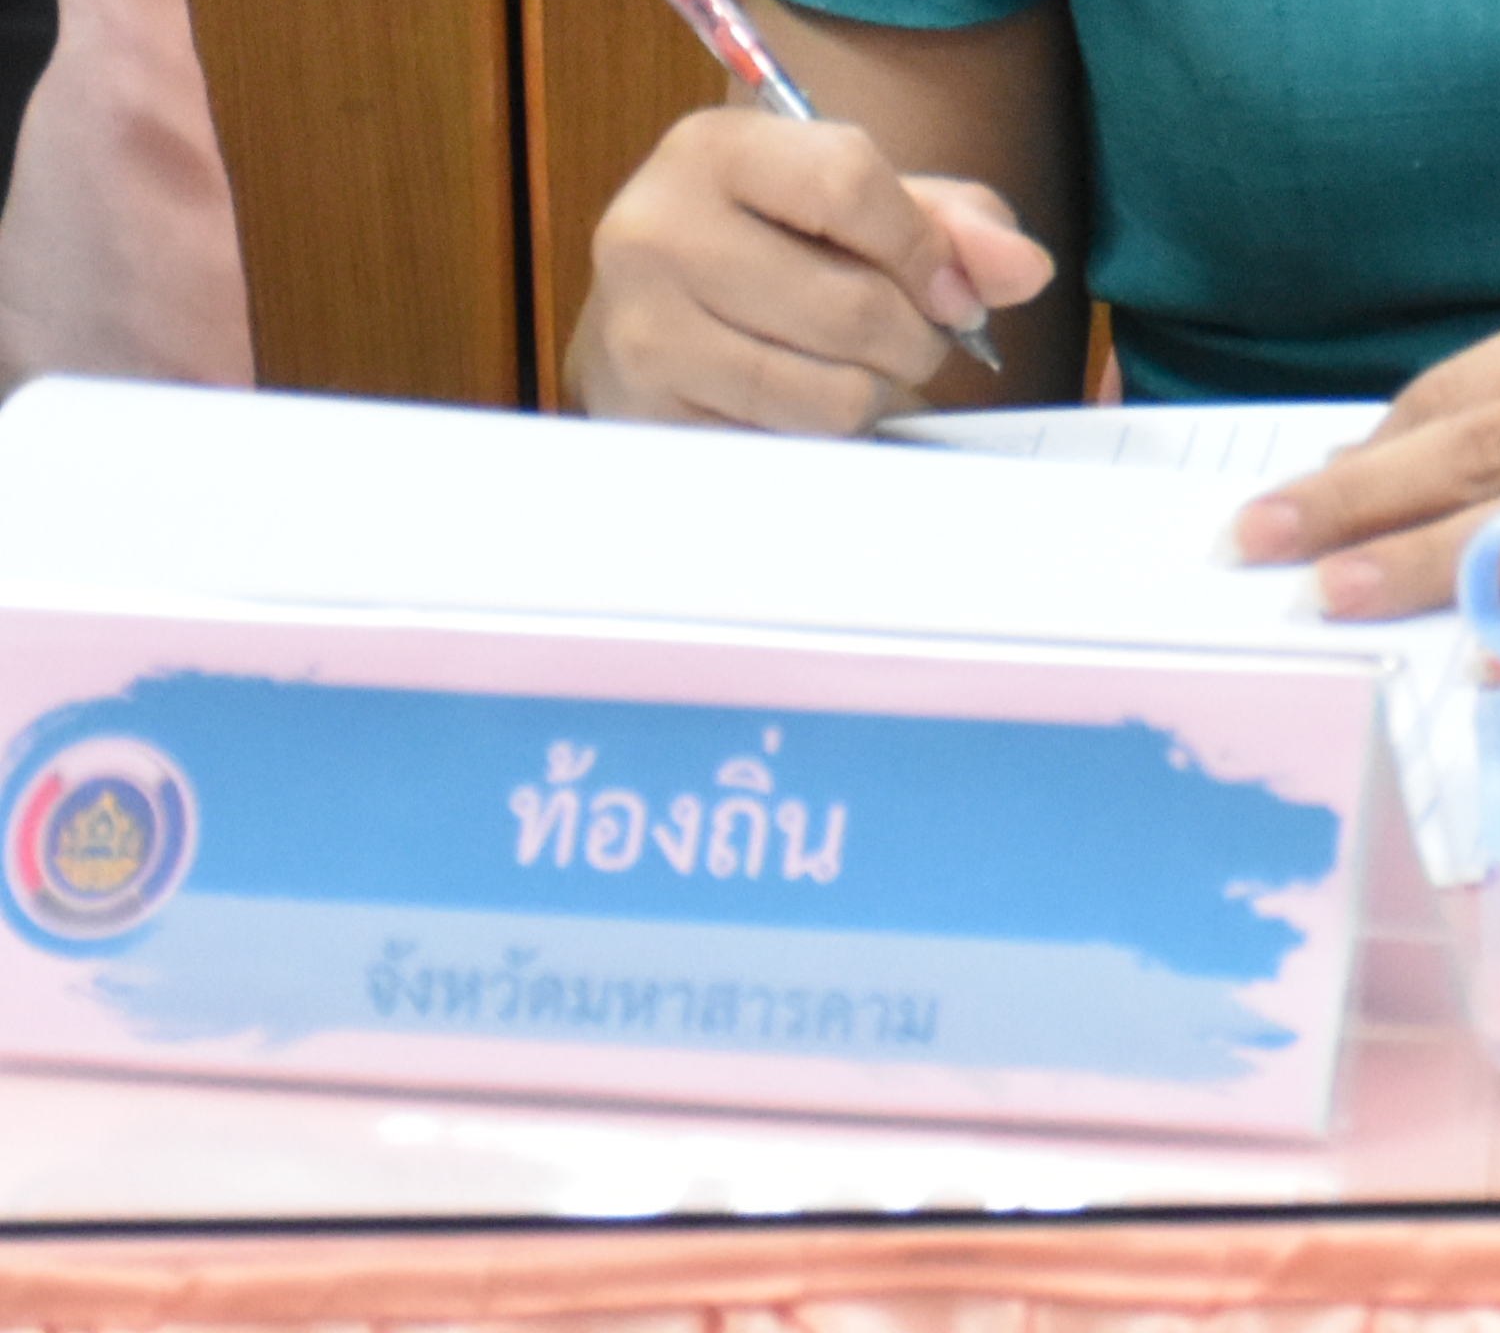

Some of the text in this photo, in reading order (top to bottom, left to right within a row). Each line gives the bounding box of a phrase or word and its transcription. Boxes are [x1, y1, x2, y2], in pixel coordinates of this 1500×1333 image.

[508, 725, 847, 884] ท้องถิ่น
[364, 937, 940, 1045] จังหวัดมหาสารคาม
